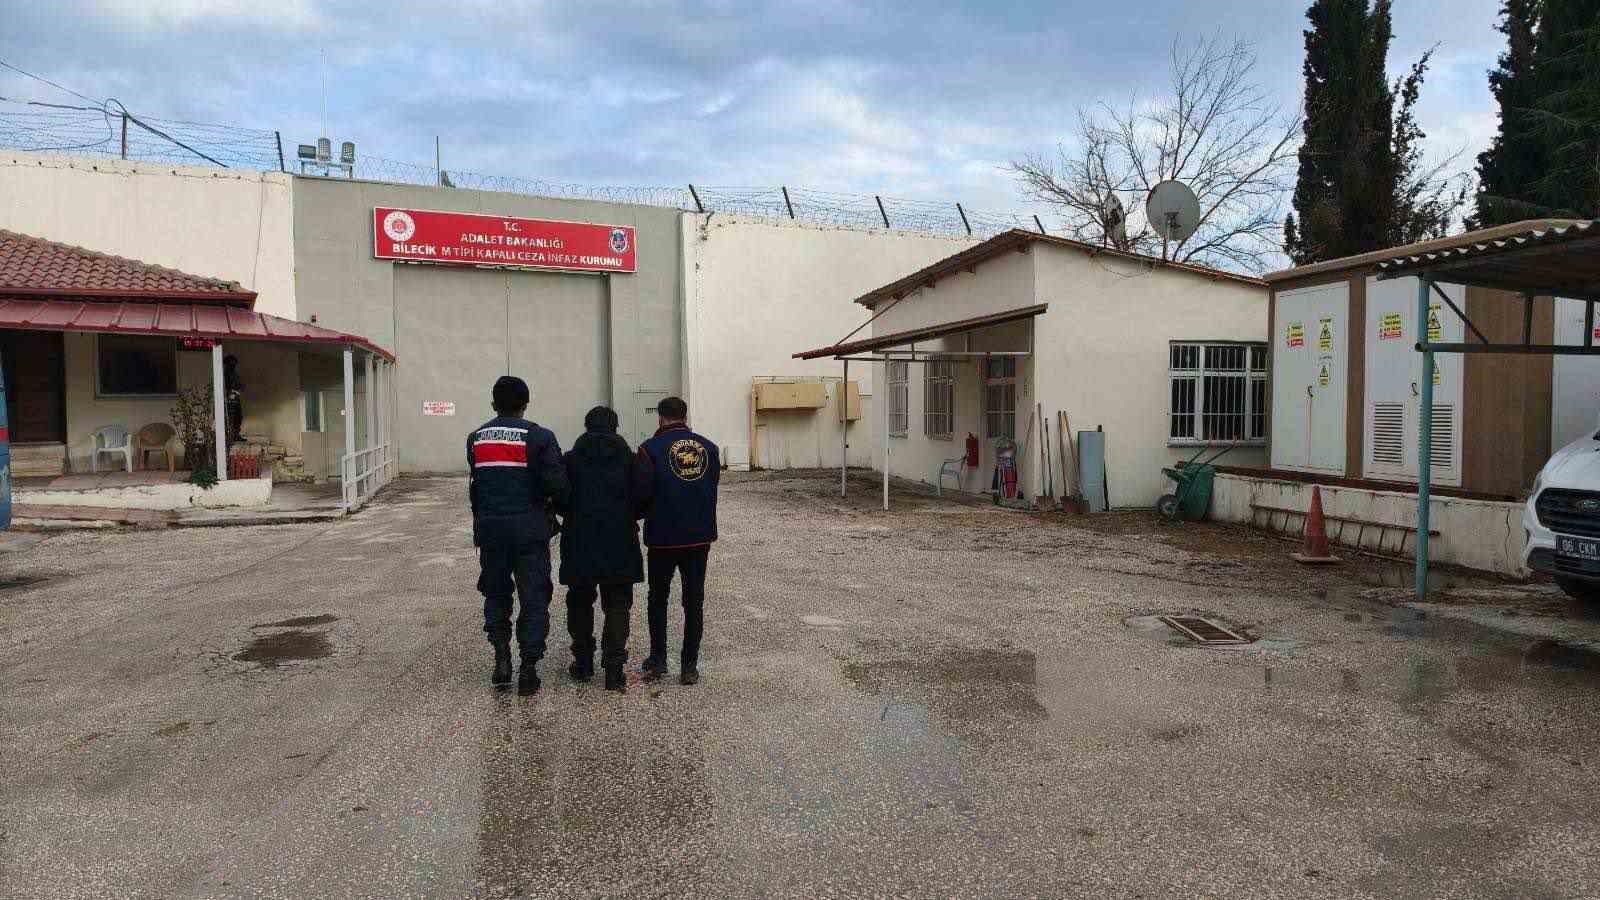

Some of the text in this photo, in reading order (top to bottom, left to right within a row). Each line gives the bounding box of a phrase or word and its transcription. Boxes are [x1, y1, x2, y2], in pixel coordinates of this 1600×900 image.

[503, 221, 522, 232] T.C.
[460, 232, 565, 249] ADALET BAKANLIĞI
[392, 242, 623, 267] BİLECİK M TİPİ KAPALI CEZA İNFAZ KURUMU
